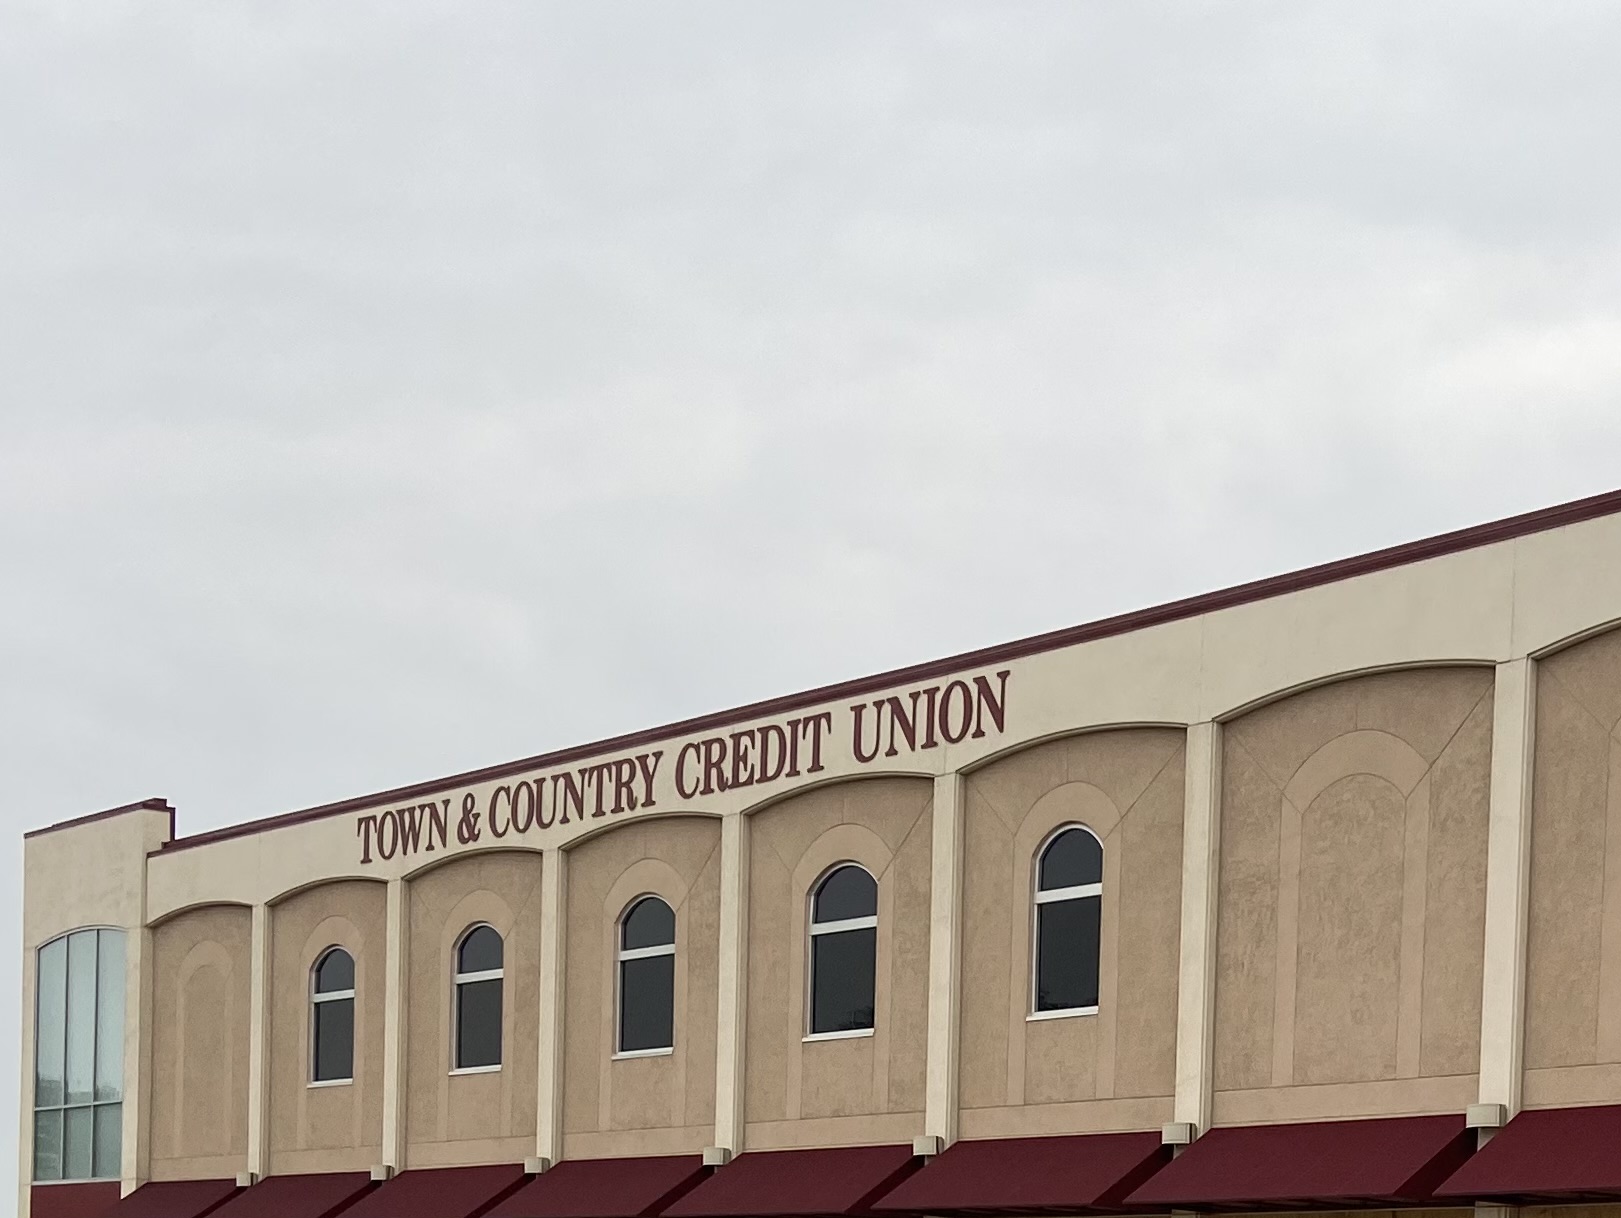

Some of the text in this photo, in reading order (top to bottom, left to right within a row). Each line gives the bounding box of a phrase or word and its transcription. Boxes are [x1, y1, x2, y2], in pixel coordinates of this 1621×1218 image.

[357, 670, 1010, 864] TOWN & COUNTRY CREDIT UNION
